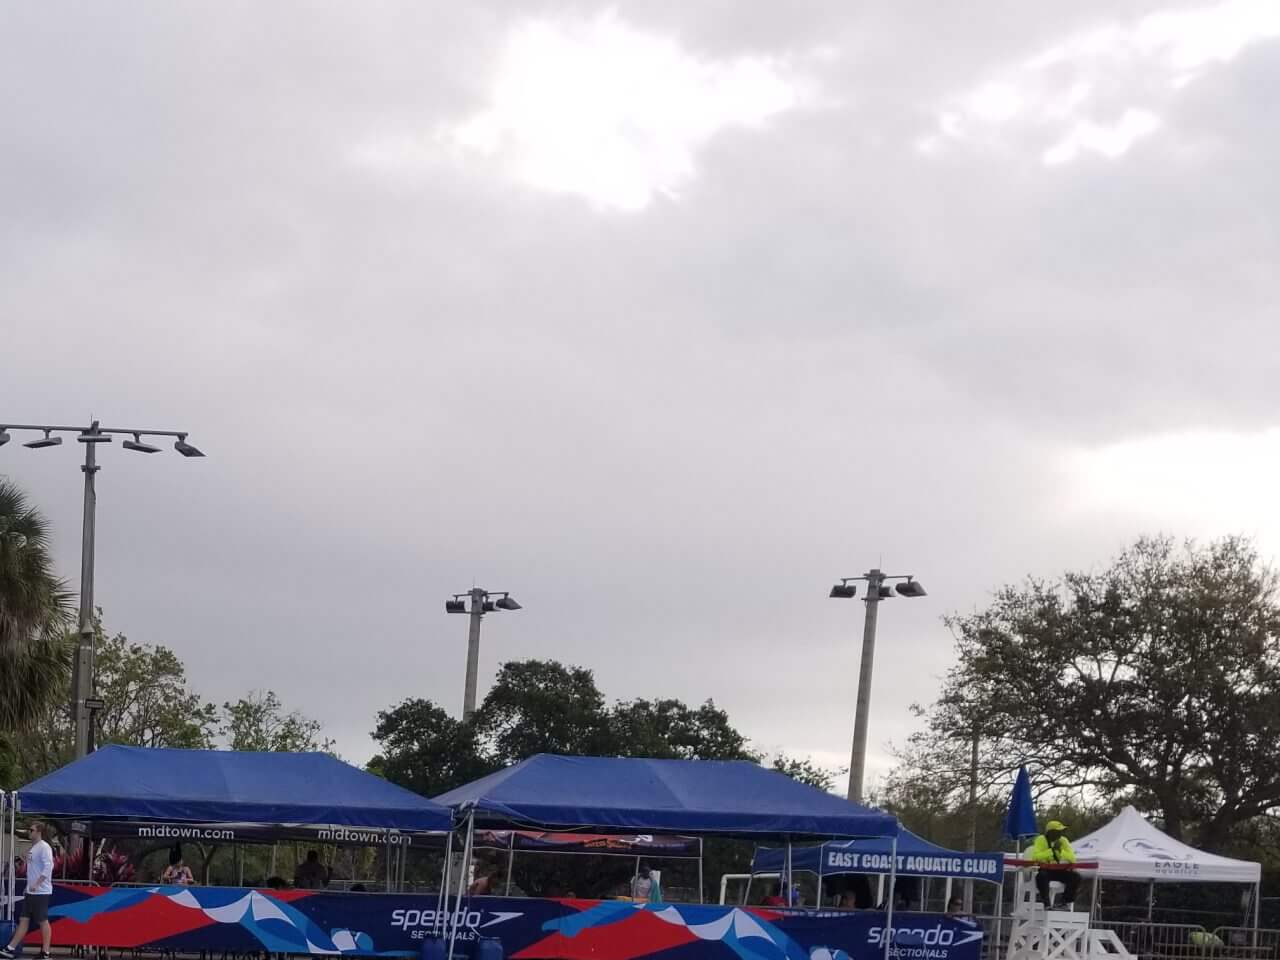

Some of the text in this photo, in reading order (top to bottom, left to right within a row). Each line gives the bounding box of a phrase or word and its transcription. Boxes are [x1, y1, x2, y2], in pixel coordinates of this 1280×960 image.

[138, 825, 234, 839] midtown.com
[828, 852, 997, 874] EAST COAST AQUATIC CLUB
